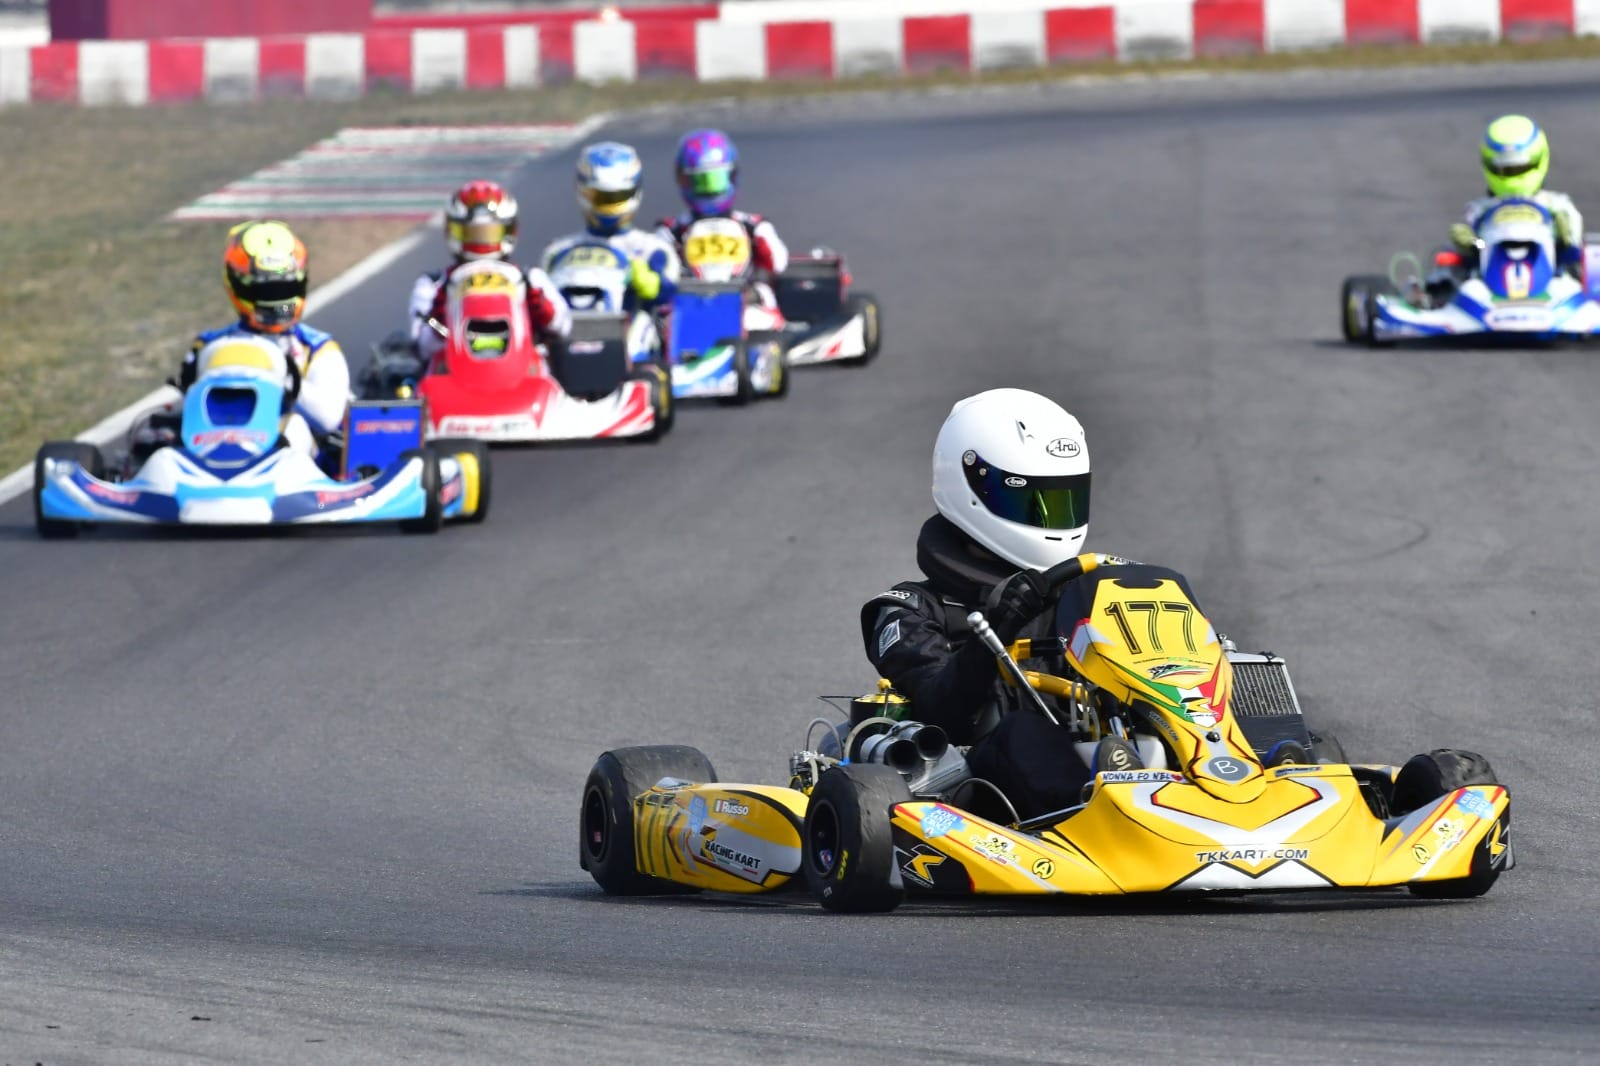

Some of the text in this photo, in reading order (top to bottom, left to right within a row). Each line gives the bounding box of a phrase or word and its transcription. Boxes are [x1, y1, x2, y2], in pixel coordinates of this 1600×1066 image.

[694, 233, 740, 259] 352
[1047, 438, 1078, 454] Arai
[1103, 600, 1198, 655] 177
[1215, 760, 1238, 775] B
[1103, 772, 1133, 781] NONNA
[704, 839, 761, 869] RACING KART
[1196, 849, 1308, 862] TKKART.COM
